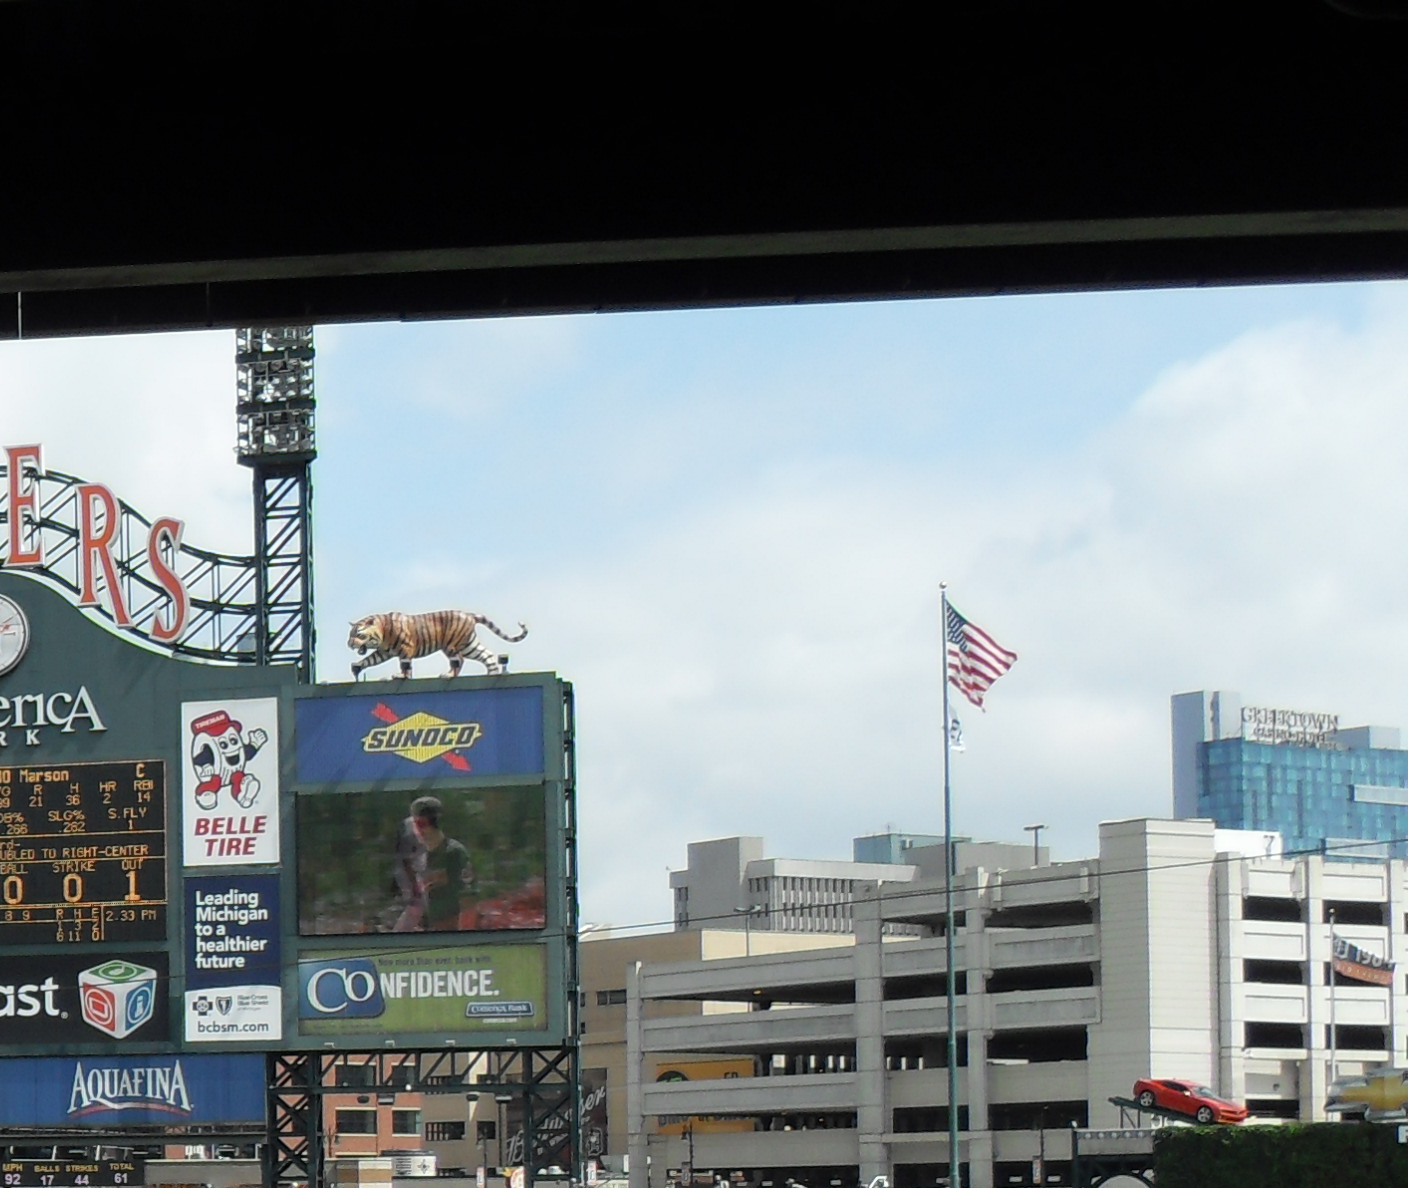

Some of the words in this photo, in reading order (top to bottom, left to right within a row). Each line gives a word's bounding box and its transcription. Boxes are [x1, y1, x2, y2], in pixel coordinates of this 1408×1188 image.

[367, 725, 476, 751] SUNOCO
[19, 769, 69, 783] Marson
[136, 763, 145, 778] C
[99, 781, 117, 792] HR
[48, 810, 85, 821] SLG%
[194, 815, 267, 836] BELLE
[42, 849, 56, 859] TO
[63, 845, 148, 858] RIGHT-CENTER
[205, 837, 256, 857] TIRE
[0, 864, 28, 874] BALL
[52, 860, 95, 873] STRIKE
[122, 858, 143, 870] OUT
[3, 875, 24, 905] 0
[63, 873, 82, 902] 0
[124, 871, 141, 901] 1
[196, 890, 259, 908] Leading
[141, 909, 157, 920] PM
[196, 906, 268, 925] Michigan
[195, 923, 212, 936] to
[216, 926, 226, 936] a
[196, 936, 268, 952] healthier
[195, 953, 245, 970] future
[198, 1021, 269, 1034] bcbsm.com
[67, 1059, 191, 1114] AQUAFINA
[109, 1162, 134, 1170] TOTAL
[5, 1173, 21, 1185] 92
[40, 1174, 54, 1185] 17
[74, 1174, 89, 1185] 44
[114, 1172, 128, 1184] 61
